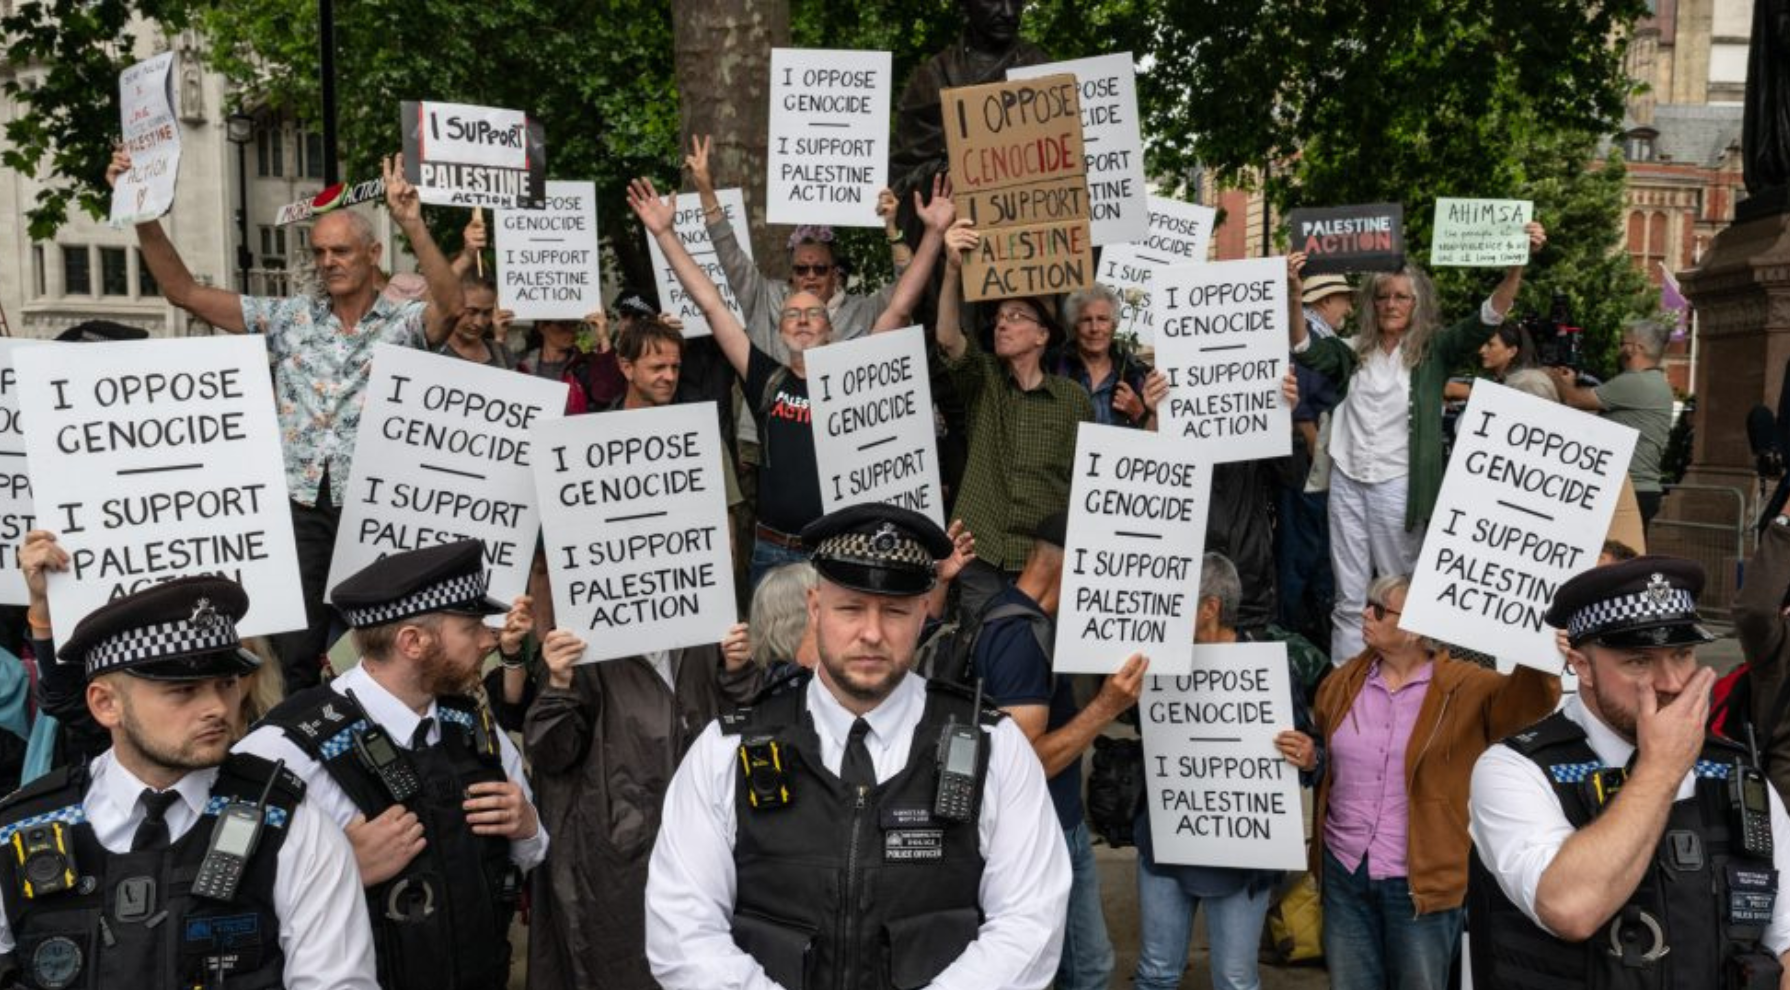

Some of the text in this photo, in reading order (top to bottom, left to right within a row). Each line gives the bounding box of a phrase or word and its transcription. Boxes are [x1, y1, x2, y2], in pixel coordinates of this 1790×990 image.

[783, 68, 877, 89] I OPPOSE
[784, 94, 872, 114] GENOCIDE
[957, 84, 1076, 139] I OPPOSE
[431, 112, 440, 140] I
[778, 137, 875, 156] I SUPPORT
[962, 133, 1076, 186] GENOCIDE
[421, 163, 530, 197] PALESTINE
[782, 164, 874, 184] PALESTINE
[451, 191, 512, 208] ACTION
[545, 196, 583, 211] POSE
[789, 184, 861, 203] ACTION
[969, 197, 977, 226] I
[989, 187, 1084, 225] SUPPORT
[504, 216, 586, 231] GENOCIDE
[1149, 212, 1199, 237] PPOSE
[1302, 215, 1391, 237] PALESTINE
[506, 250, 590, 264] I SUPPORT
[962, 226, 1084, 265] ALESTINE
[1304, 232, 1393, 254] ACTION
[506, 271, 590, 287] PALESTINE
[664, 268, 675, 282] I
[981, 259, 1084, 296] ACTION
[1107, 261, 1117, 278] I
[516, 286, 582, 301] ACTION
[1165, 287, 1178, 309] I
[1189, 280, 1275, 307] OPPOSE
[1163, 309, 1275, 337] GENOCIDE
[820, 356, 913, 402] I OPPOSE
[1168, 359, 1280, 387] I SUPPORT
[50, 379, 73, 410] I
[94, 368, 243, 408] OPPOSE
[386, 375, 542, 430] I OPPOSE
[1170, 390, 1277, 418] PALESTINE
[828, 390, 916, 437] GENOCIDE
[1183, 414, 1268, 439] ACTION
[56, 412, 246, 454] GENOCIDE
[382, 416, 531, 467] GENOCIDE
[1473, 411, 1613, 477] I OPPOSE
[552, 432, 701, 472] I OPPOSE
[832, 475, 844, 501] I
[850, 449, 925, 496] SUPPORT
[1086, 452, 1195, 488] I OPPOSE
[1465, 451, 1600, 511] GENOCIDE
[361, 477, 528, 528] I SUPPORT
[559, 467, 706, 507] GENOCIDE
[58, 503, 85, 534] I
[102, 484, 266, 529] SUPPORT
[1085, 489, 1194, 522] GENOCIDE
[562, 526, 716, 570] I SUPPORT
[1442, 509, 1584, 569] I SUPPORT
[73, 531, 269, 581] PALESTINE
[1073, 548, 1193, 581] I SUPPORT
[569, 563, 716, 606] PALESTINE
[1436, 548, 1561, 605] PALESTIN
[589, 593, 700, 630] ACTION
[1076, 587, 1184, 617] PALESTINE
[1437, 582, 1547, 633] ACTION
[1081, 617, 1166, 643] ACTION
[1176, 668, 1270, 692] OPPOSE
[1149, 701, 1275, 724] GENOCIDE
[1154, 756, 1286, 780] I SUPPORT
[1161, 789, 1286, 815] PALESTINE
[1176, 815, 1271, 840] ACTION
